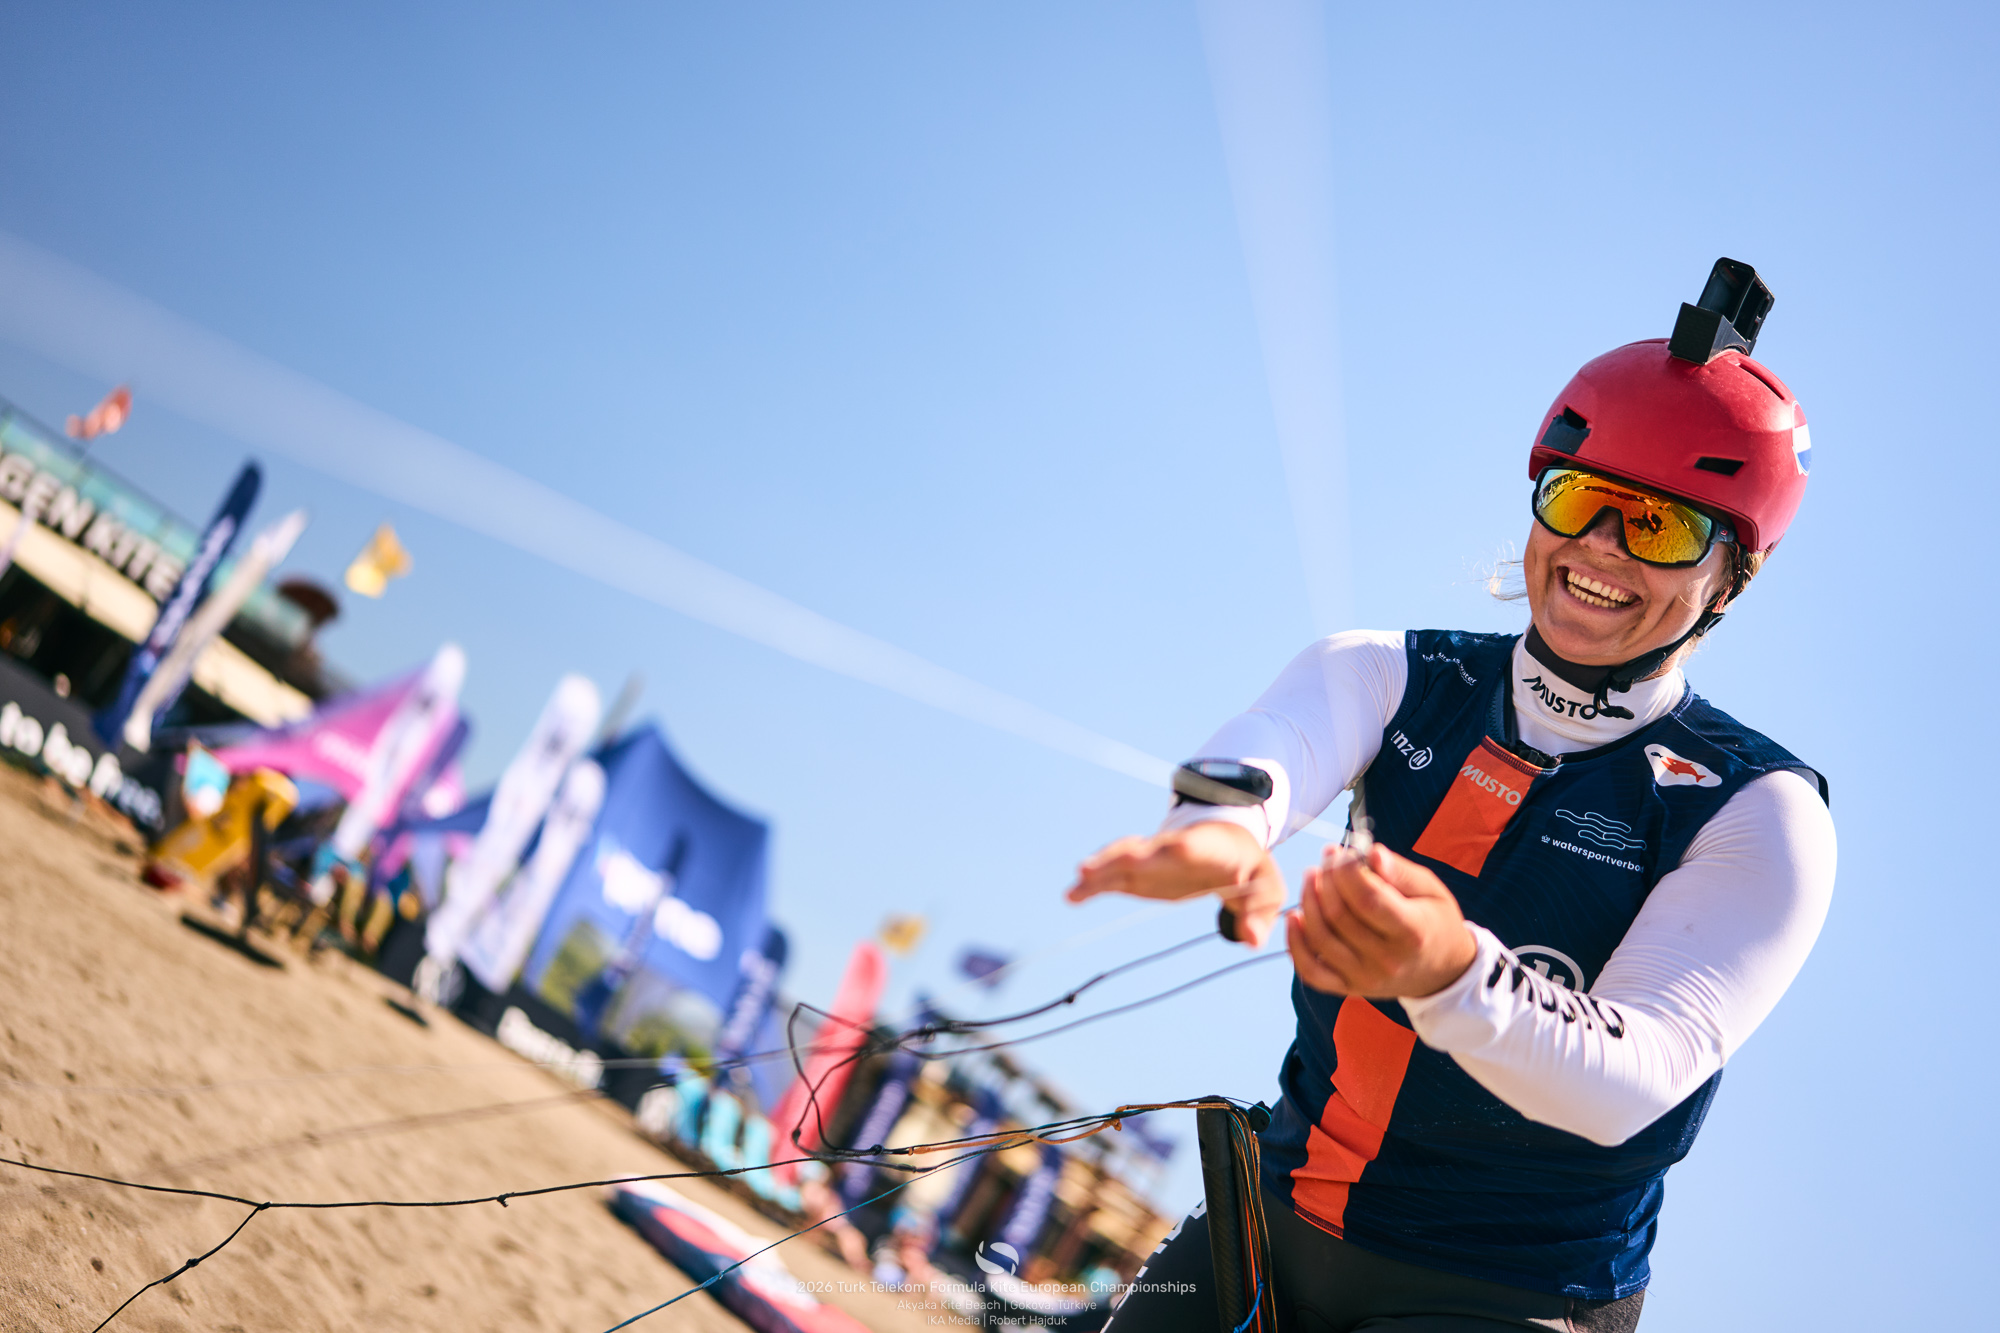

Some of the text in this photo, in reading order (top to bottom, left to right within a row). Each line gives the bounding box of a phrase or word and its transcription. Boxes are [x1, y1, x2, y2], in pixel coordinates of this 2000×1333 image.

[1522, 676, 1598, 720] MUSTO
[1460, 764, 1522, 806] MUSTO
[1552, 839, 1644, 873] watersportverbo
